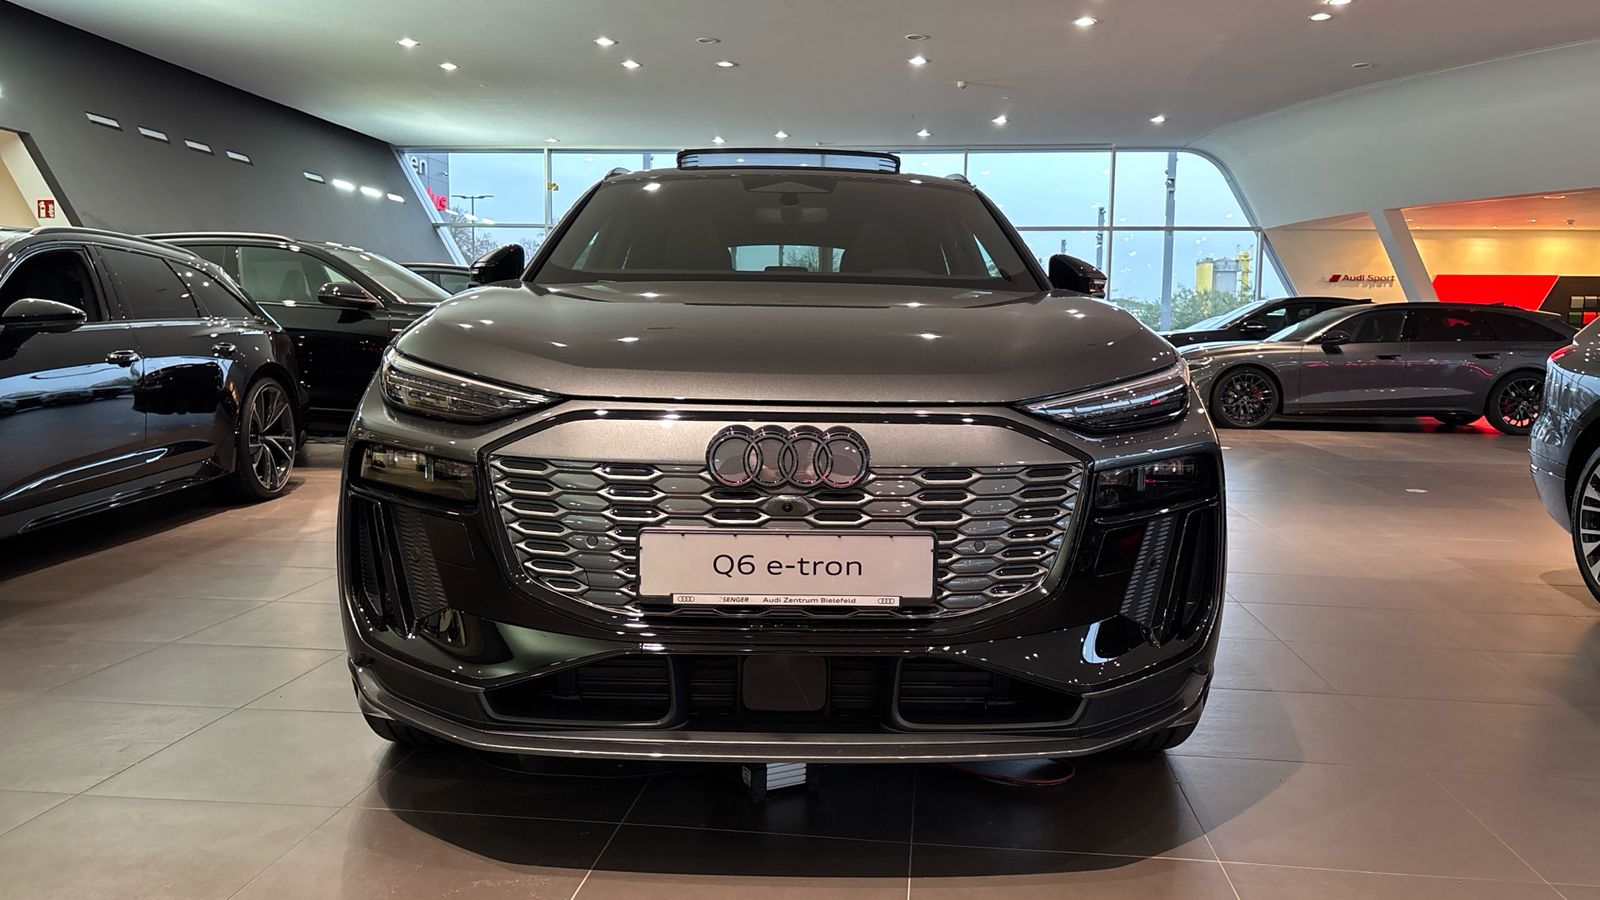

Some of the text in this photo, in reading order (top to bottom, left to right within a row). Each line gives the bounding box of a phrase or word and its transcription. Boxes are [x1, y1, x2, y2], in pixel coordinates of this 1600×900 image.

[1342, 274, 1395, 283] Audi Sport
[713, 554, 863, 578] Q6 e-tron
